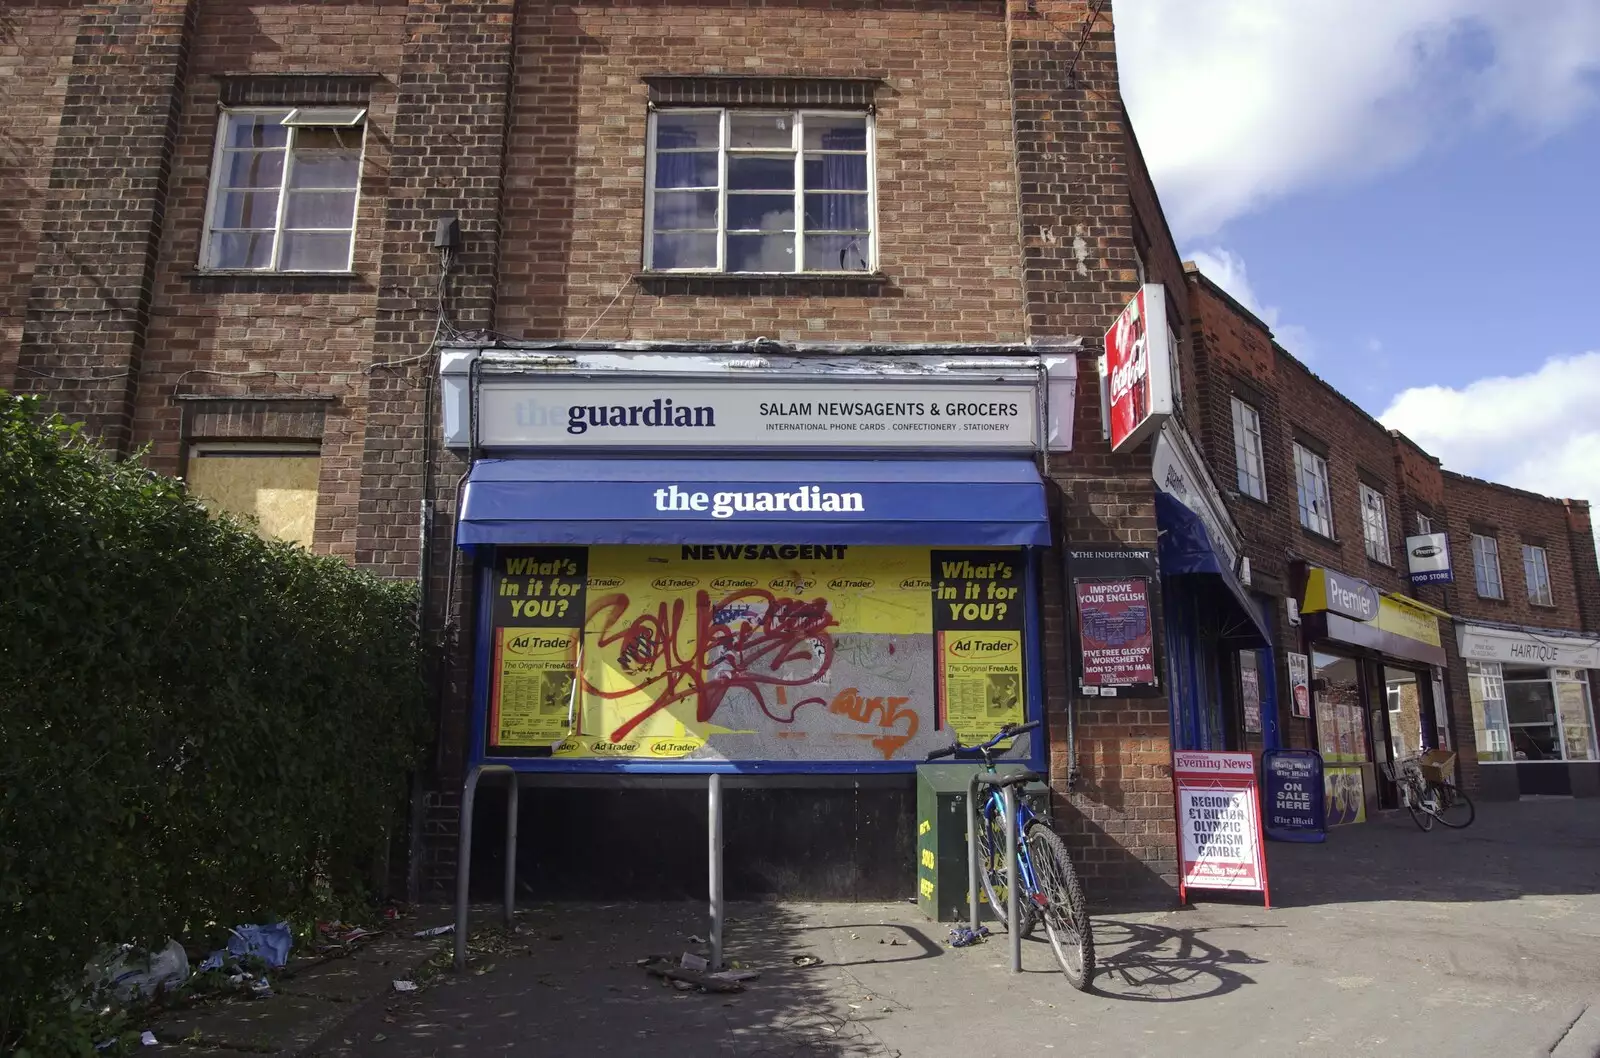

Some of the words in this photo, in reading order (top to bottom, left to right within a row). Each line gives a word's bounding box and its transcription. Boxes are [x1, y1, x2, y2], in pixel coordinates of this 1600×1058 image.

[760, 403, 812, 416] SALAM
[818, 403, 925, 416] NEWSAGENTS
[930, 403, 941, 416] &
[946, 403, 1018, 417] GROCERS
[567, 398, 716, 435] guardian
[766, 423, 828, 431] INTERNATIONAL
[830, 423, 857, 431] PHONE
[859, 423, 886, 431] CARDS
[892, 423, 957, 431] CONFECTIONERY
[963, 423, 1010, 431] STATIONERY
[653, 485, 710, 511] the
[711, 485, 865, 519] guardian
[681, 544, 848, 561] NEWSAGENT
[1079, 551, 1094, 559] THE
[1095, 551, 1150, 559] INDEPENDENT
[506, 557, 577, 576] What's
[942, 560, 1012, 579] What's
[1430, 573, 1449, 581] STORE
[500, 578, 520, 596] in
[527, 578, 544, 596] it
[550, 578, 581, 597] for
[594, 578, 621, 587] Trader
[655, 579, 667, 587] Ad
[668, 579, 696, 588] Trader
[714, 579, 725, 587] Ad
[727, 579, 754, 588] Trader
[831, 580, 842, 588] Ad
[845, 580, 872, 588] Trader
[903, 580, 914, 588] Ad
[938, 581, 957, 600] in
[965, 581, 981, 600] it
[987, 581, 1018, 600] for
[1090, 584, 1132, 594] IMPROVE
[1079, 595, 1105, 603] YOUR
[1106, 593, 1145, 602] ENGLISH
[1330, 578, 1371, 615] Premier
[511, 599, 570, 618] YOU?
[949, 602, 1008, 621] YOU?
[512, 637, 530, 648] Ad
[532, 637, 572, 648] Trader
[955, 640, 971, 651] Ad
[974, 640, 1013, 651] Trader
[1083, 649, 1101, 657] FIVE
[1102, 648, 1120, 656] FREE
[1121, 647, 1151, 655] GLOSSY
[1091, 655, 1144, 664] WORKSHEETS
[504, 661, 517, 669] The
[518, 661, 544, 671] Original
[545, 661, 575, 669] FreeAds
[948, 664, 961, 672] The
[962, 664, 987, 673] Original
[988, 664, 1018, 672] FreeAds
[594, 743, 608, 751] Ad
[608, 743, 636, 751] Trader
[655, 743, 668, 751] Ad
[668, 744, 697, 752] Trader
[1176, 758, 1220, 770] Evening
[1222, 759, 1252, 769] News
[1274, 761, 1293, 770] Daily
[1283, 782, 1302, 792] ON
[1277, 791, 1310, 801] SALE
[1276, 800, 1311, 810] HERE
[1189, 808, 1202, 819] £1
[1203, 808, 1244, 820] BILLION
[1274, 815, 1290, 824] The
[1292, 817, 1314, 825] Mail
[1194, 820, 1241, 833] OLYMPIC
[1193, 833, 1244, 845] TOURISM
